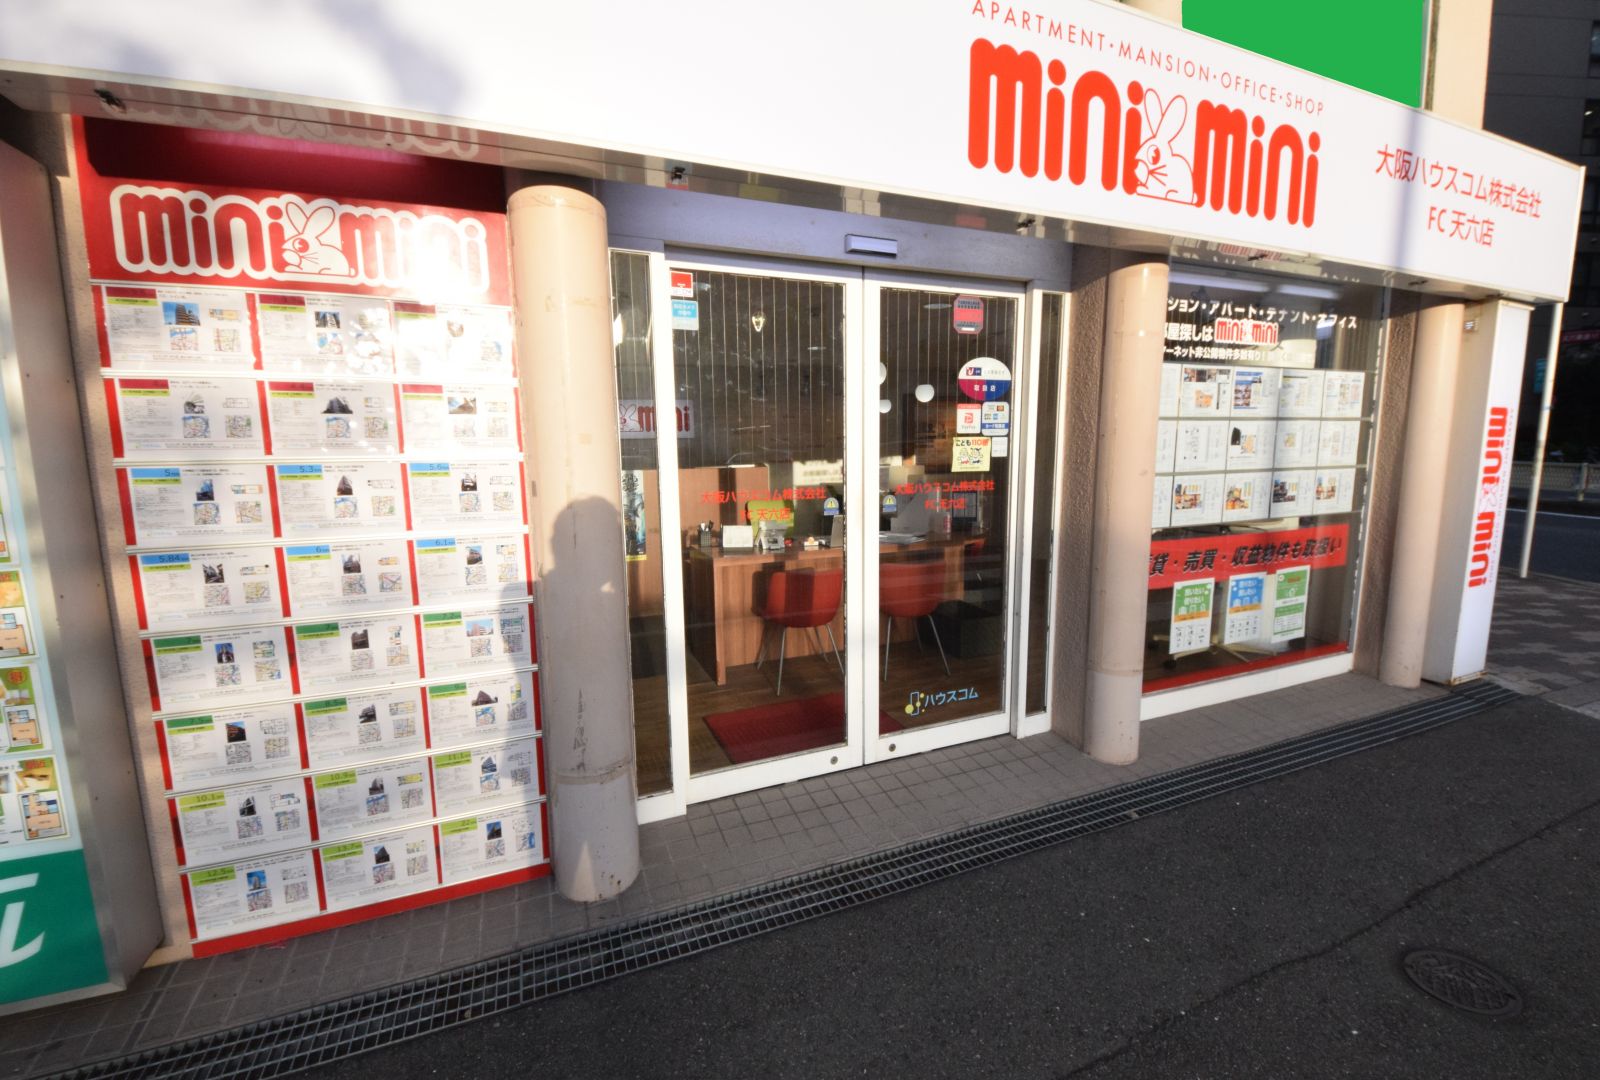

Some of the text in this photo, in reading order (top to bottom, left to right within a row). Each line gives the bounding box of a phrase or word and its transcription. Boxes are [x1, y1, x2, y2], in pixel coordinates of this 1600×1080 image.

[972, 0, 1324, 116] APARTMENT MANSION OFFICE SHOP
[968, 37, 1321, 228] mini mini
[1376, 143, 1541, 219] 大阪ハウスコム株式会社
[117, 190, 286, 275] mini
[1428, 206, 1495, 247] FC 天六店
[925, 687, 979, 708] ハウスコム
